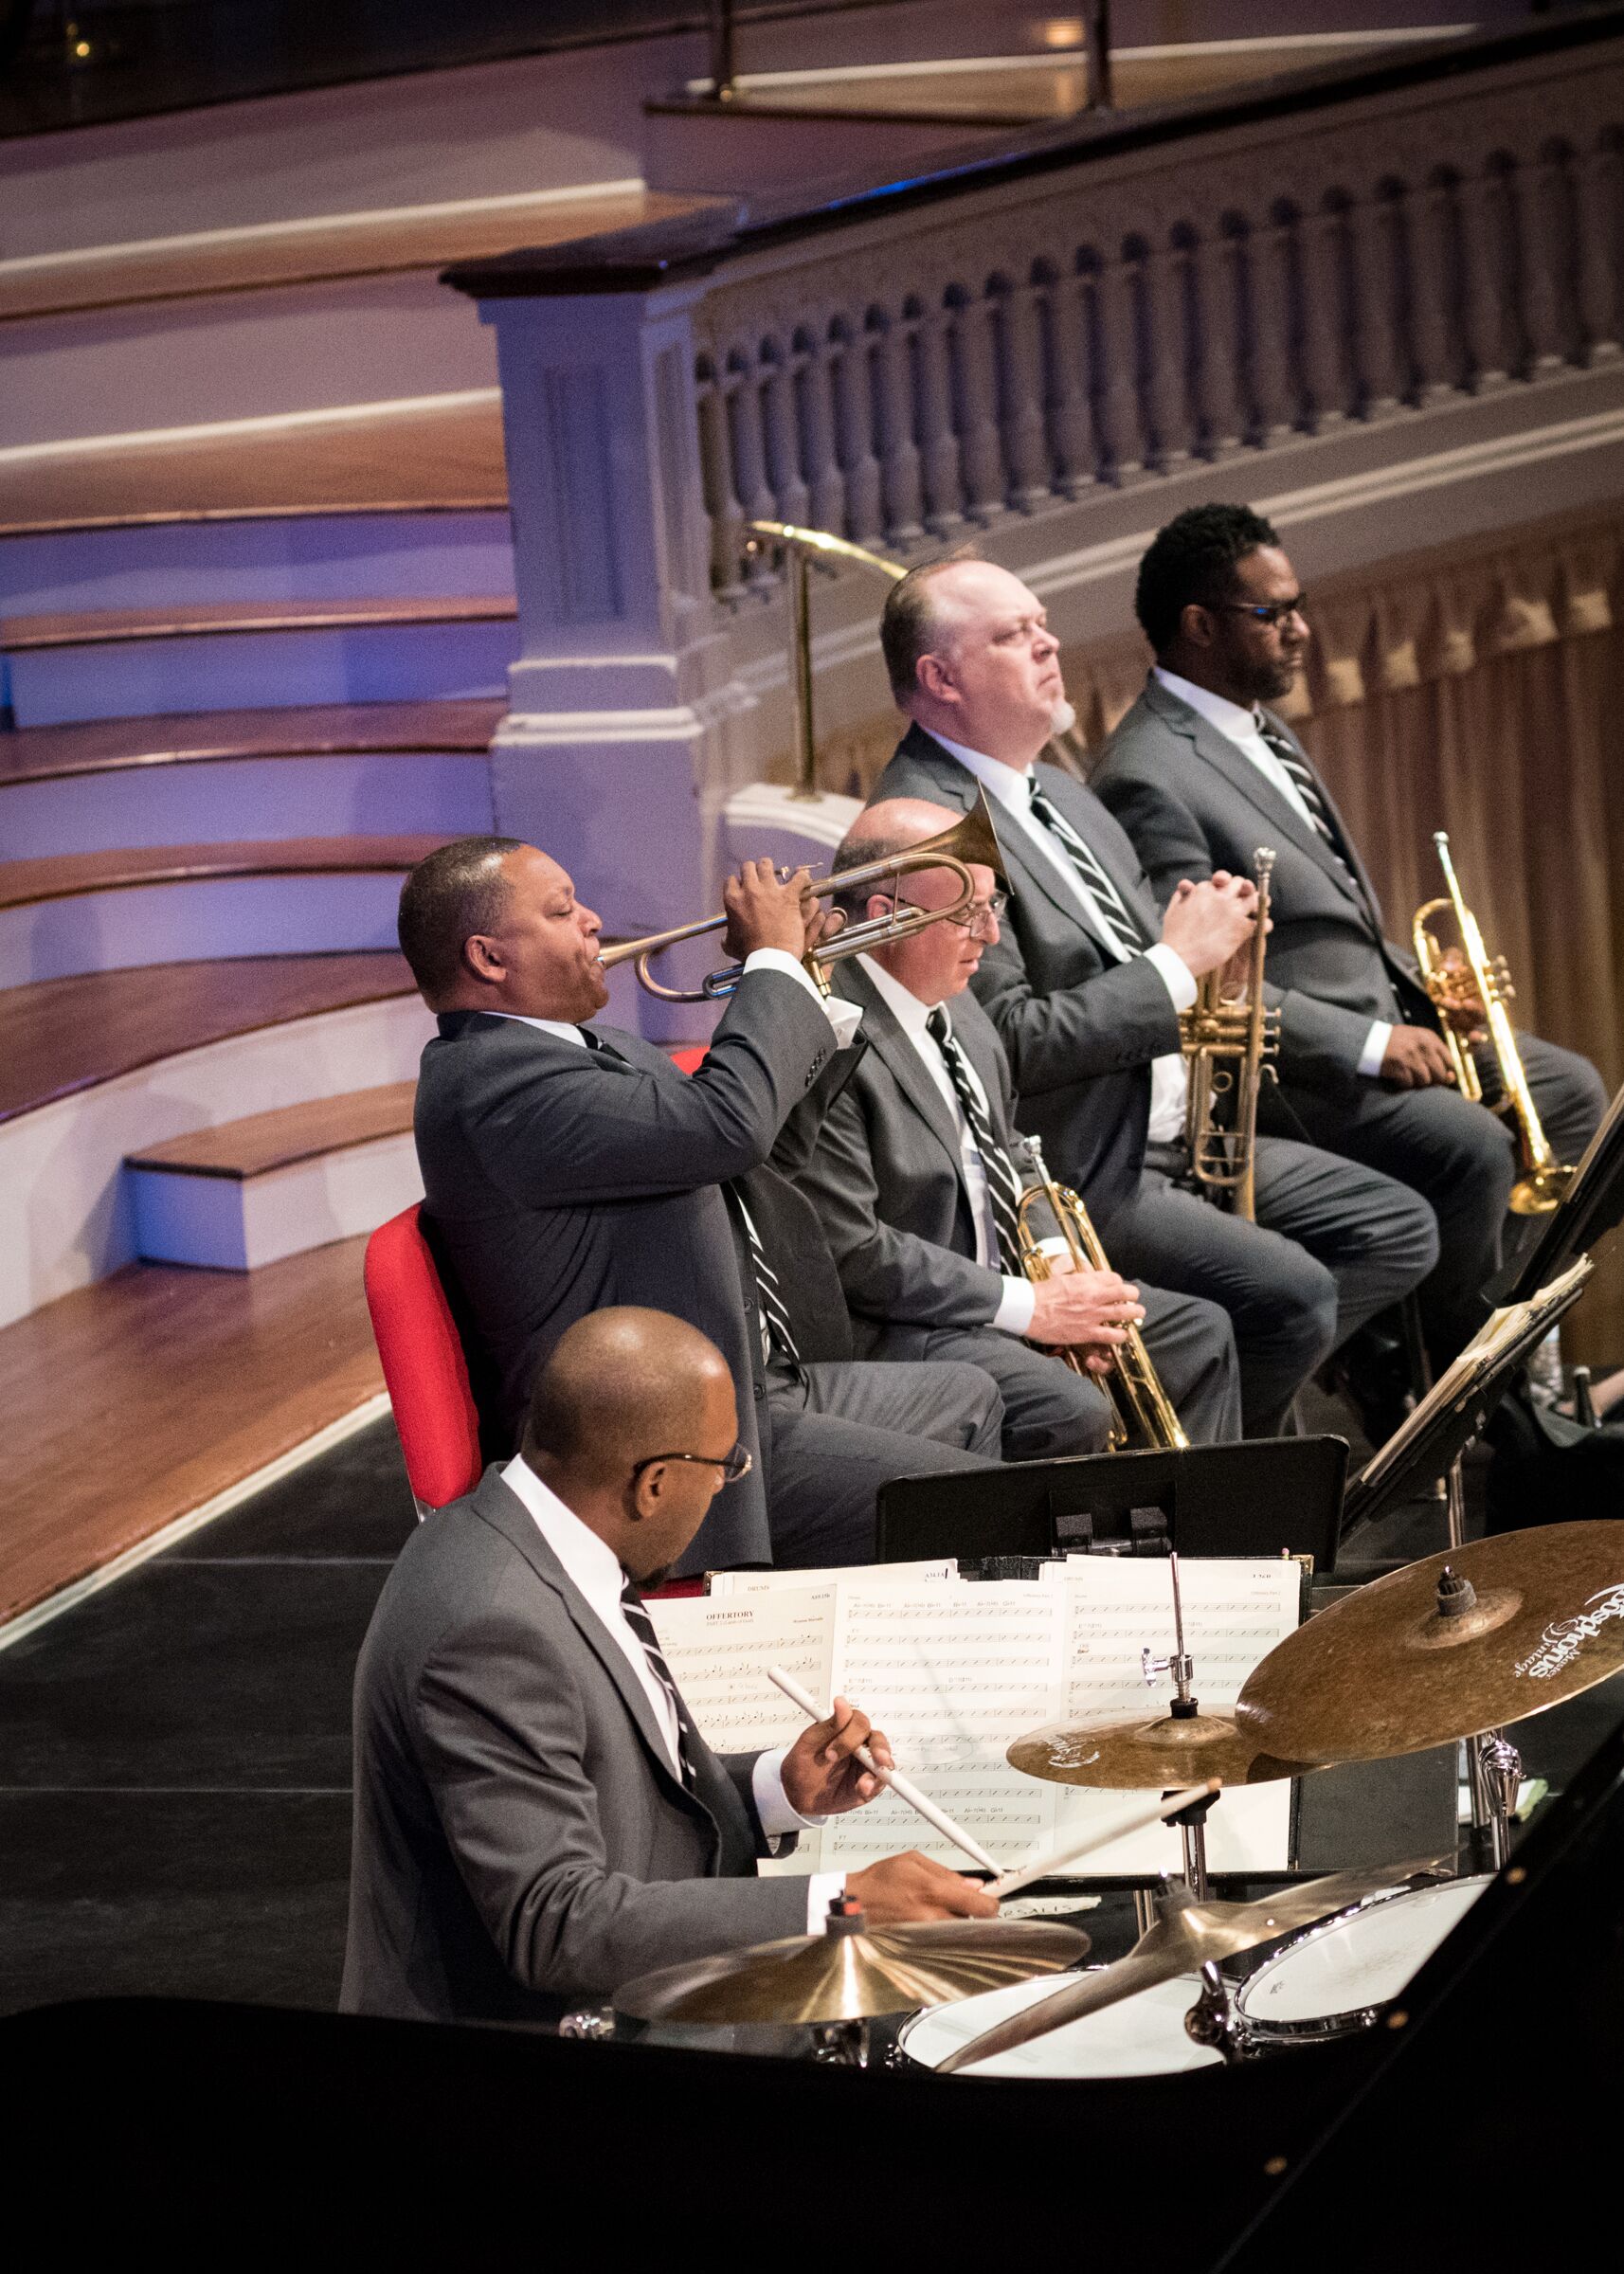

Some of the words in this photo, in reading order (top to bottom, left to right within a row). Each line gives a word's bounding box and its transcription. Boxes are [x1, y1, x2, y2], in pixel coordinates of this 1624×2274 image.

[706, 1610, 755, 1620] OFFERTORY
[1513, 1619, 1579, 1677] Vintage
[1546, 1650, 1580, 1680] Master
